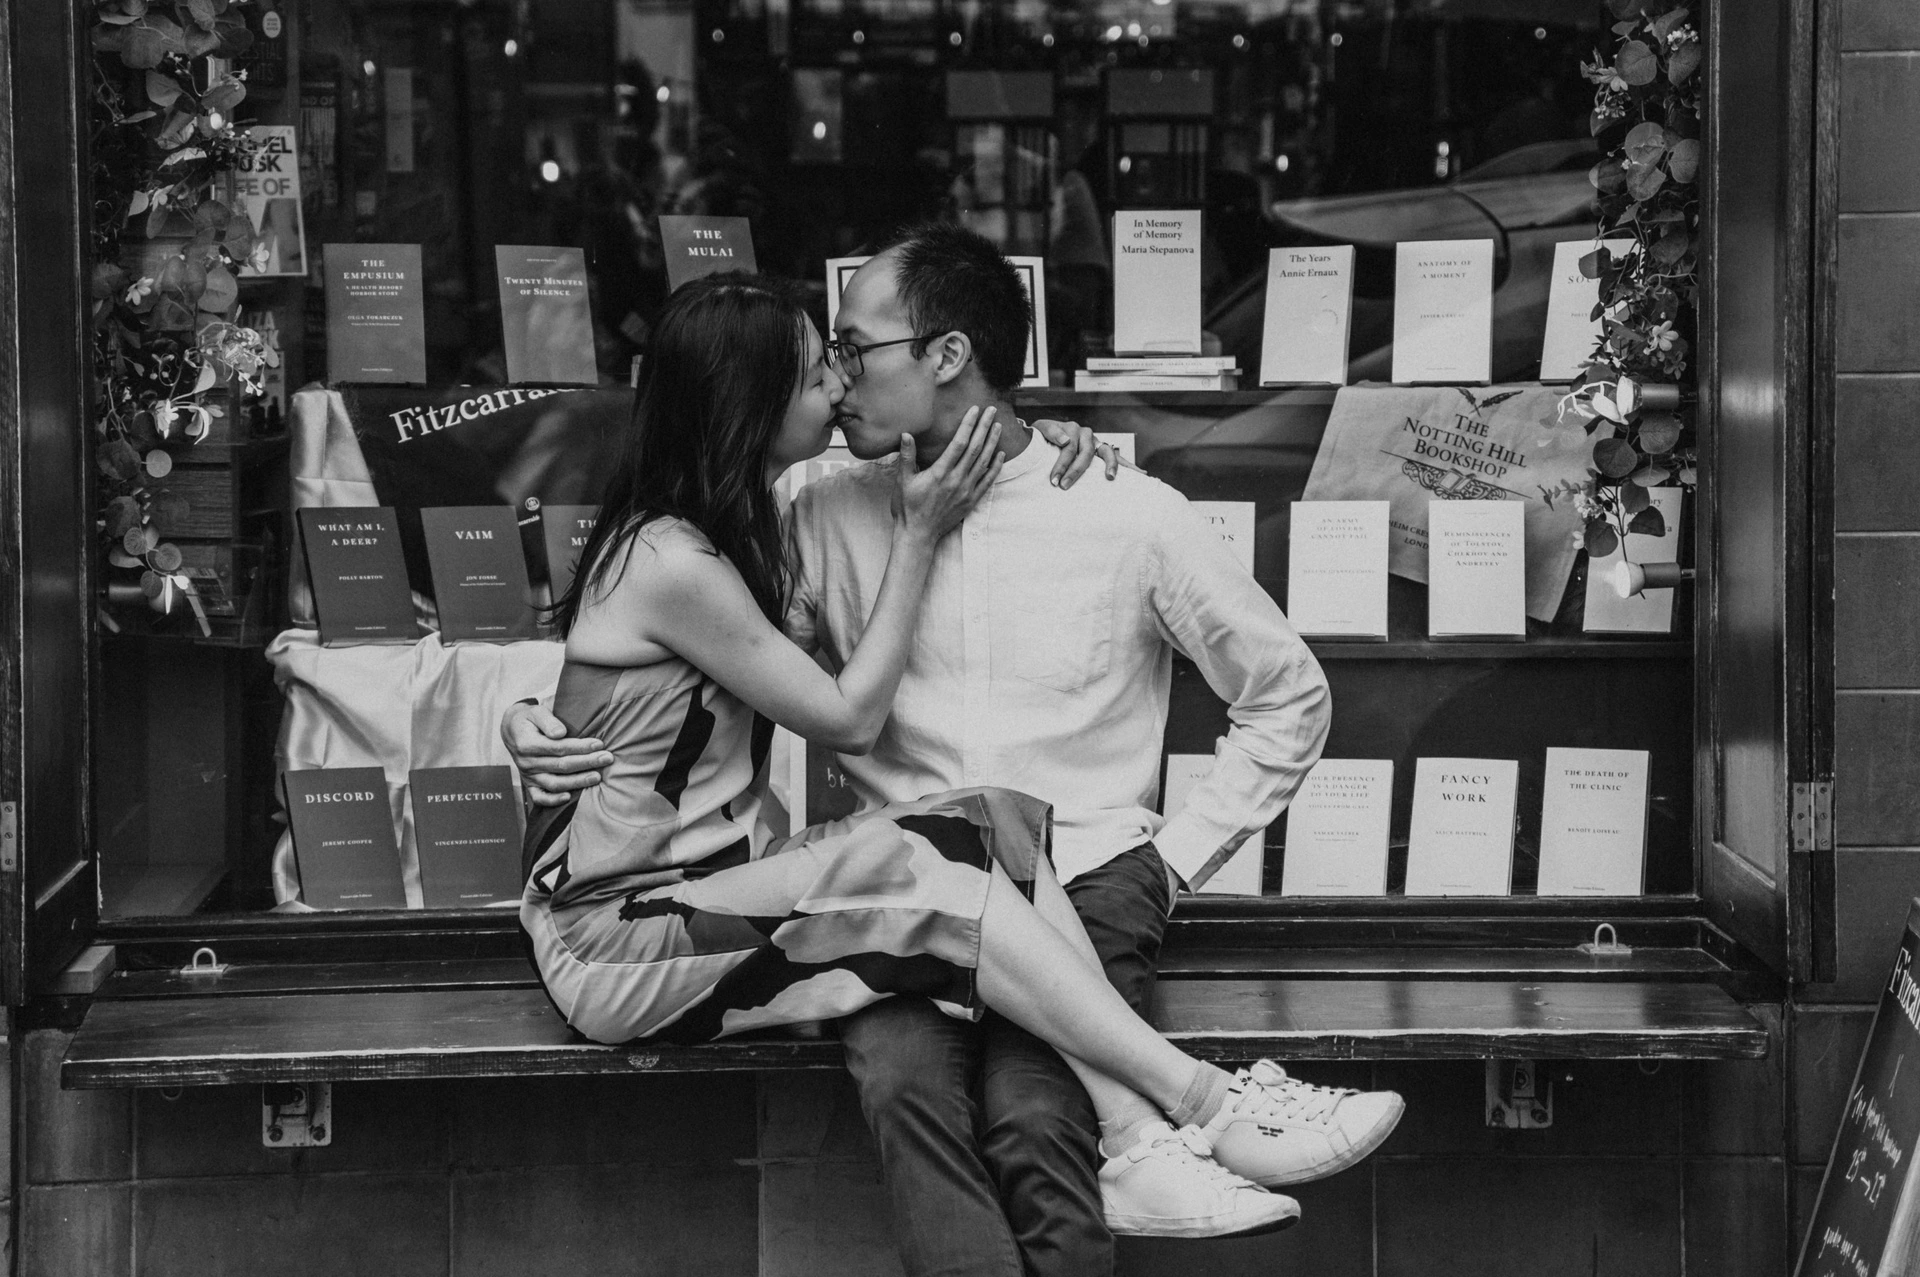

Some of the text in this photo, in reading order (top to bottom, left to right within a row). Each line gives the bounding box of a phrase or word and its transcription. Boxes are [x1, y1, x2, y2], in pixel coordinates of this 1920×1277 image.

[262, 178, 290, 196] OF
[1134, 219, 1183, 229] In Memory
[693, 230, 722, 239] THE
[1133, 230, 1183, 240] of Memory
[688, 247, 733, 257] MULAI
[1121, 245, 1194, 255] Maria Stepanova
[361, 259, 385, 267] THE
[1289, 254, 1331, 263] The Years
[343, 272, 404, 280] EMPUSIUM
[1280, 269, 1339, 278] Annie Ernaux
[504, 277, 583, 286] TWENTY MINUTES
[533, 288, 571, 296] SILENCE
[389, 388, 597, 443] Fitzcarra
[1454, 414, 1489, 437] THE
[1403, 416, 1528, 468] NOTTING HILL
[1413, 439, 1507, 479] BOOKSHOP
[356, 523, 372, 531] AM
[455, 530, 494, 540] VAIM
[1410, 527, 1429, 538] CRES
[1404, 537, 1429, 550] LOND
[1441, 775, 1491, 784] FANCY
[305, 792, 374, 803] DISCORD
[427, 792, 502, 803] PERFECTION
[1442, 793, 1487, 802] WORK
